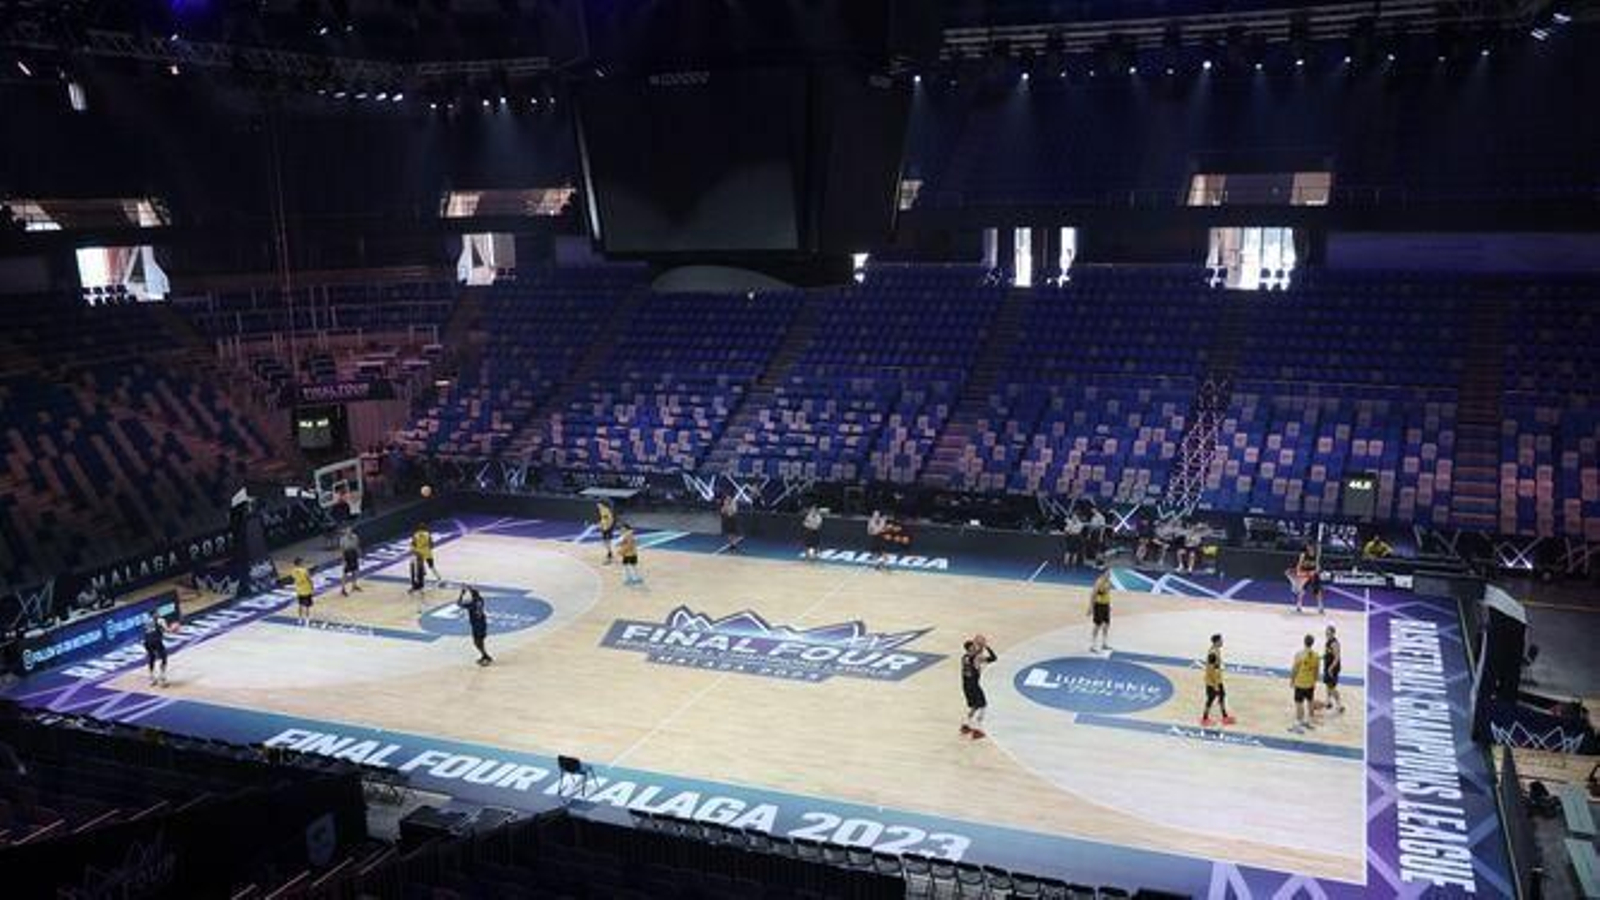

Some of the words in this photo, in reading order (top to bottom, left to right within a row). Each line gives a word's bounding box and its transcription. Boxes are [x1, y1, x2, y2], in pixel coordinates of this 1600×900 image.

[621, 624, 759, 654] FINAL
[767, 642, 919, 672] FOUR
[264, 728, 402, 768] FINAL
[398, 751, 549, 790] FOUR
[545, 770, 780, 833] MALAGA
[787, 811, 972, 861] 2023
[1397, 800, 1477, 893] LEAGUE
